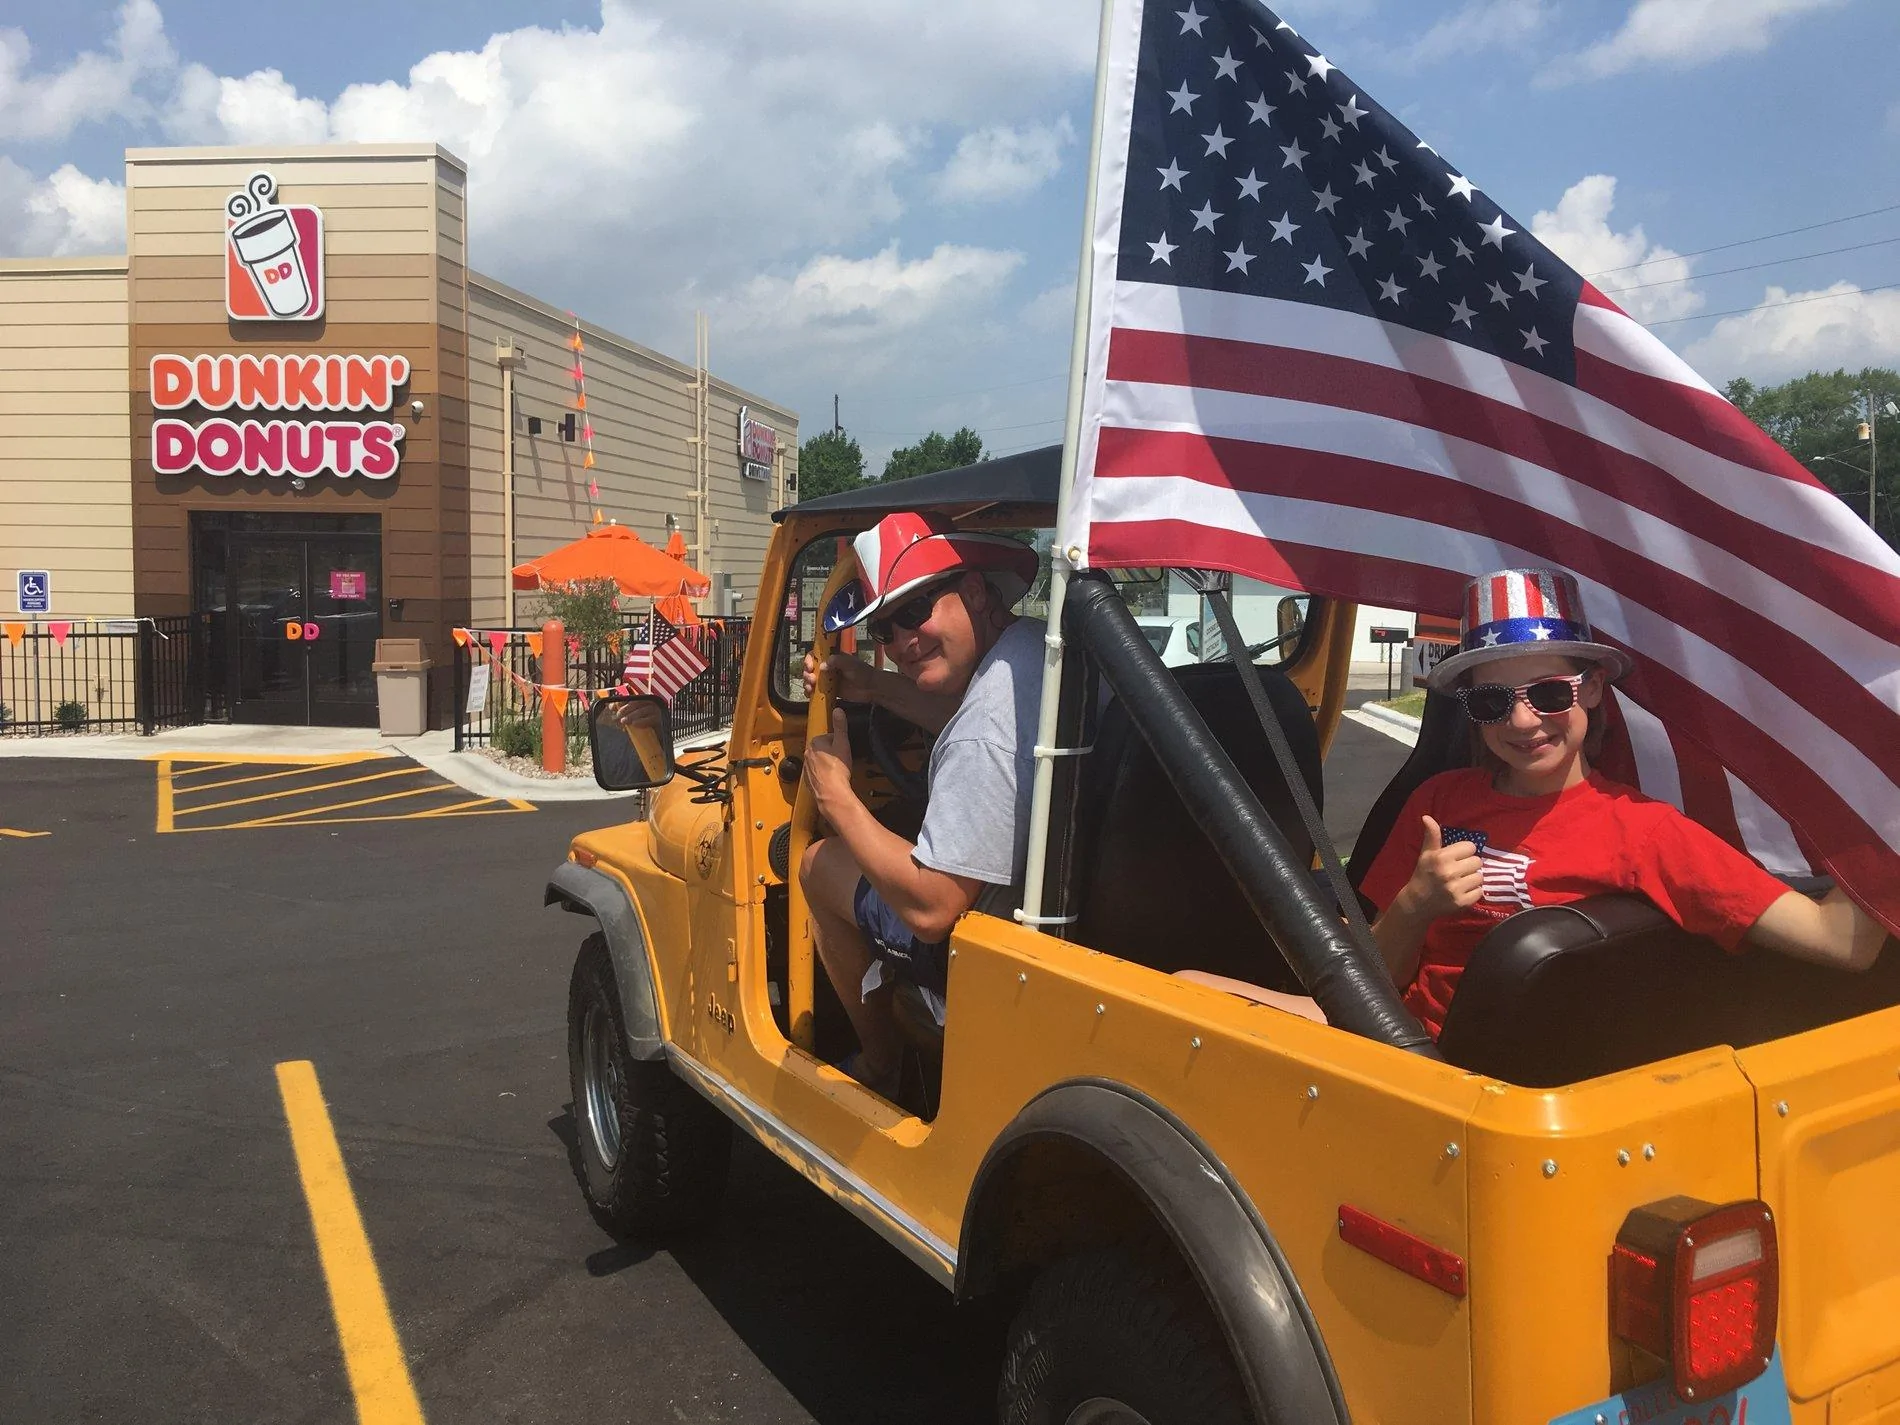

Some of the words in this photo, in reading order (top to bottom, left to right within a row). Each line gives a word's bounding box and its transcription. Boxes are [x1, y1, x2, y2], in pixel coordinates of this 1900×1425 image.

[264, 262, 292, 284] DD
[153, 358, 405, 407] DUNKIN'
[1429, 642, 1453, 660] DRI
[708, 992, 736, 1036] Jeep
